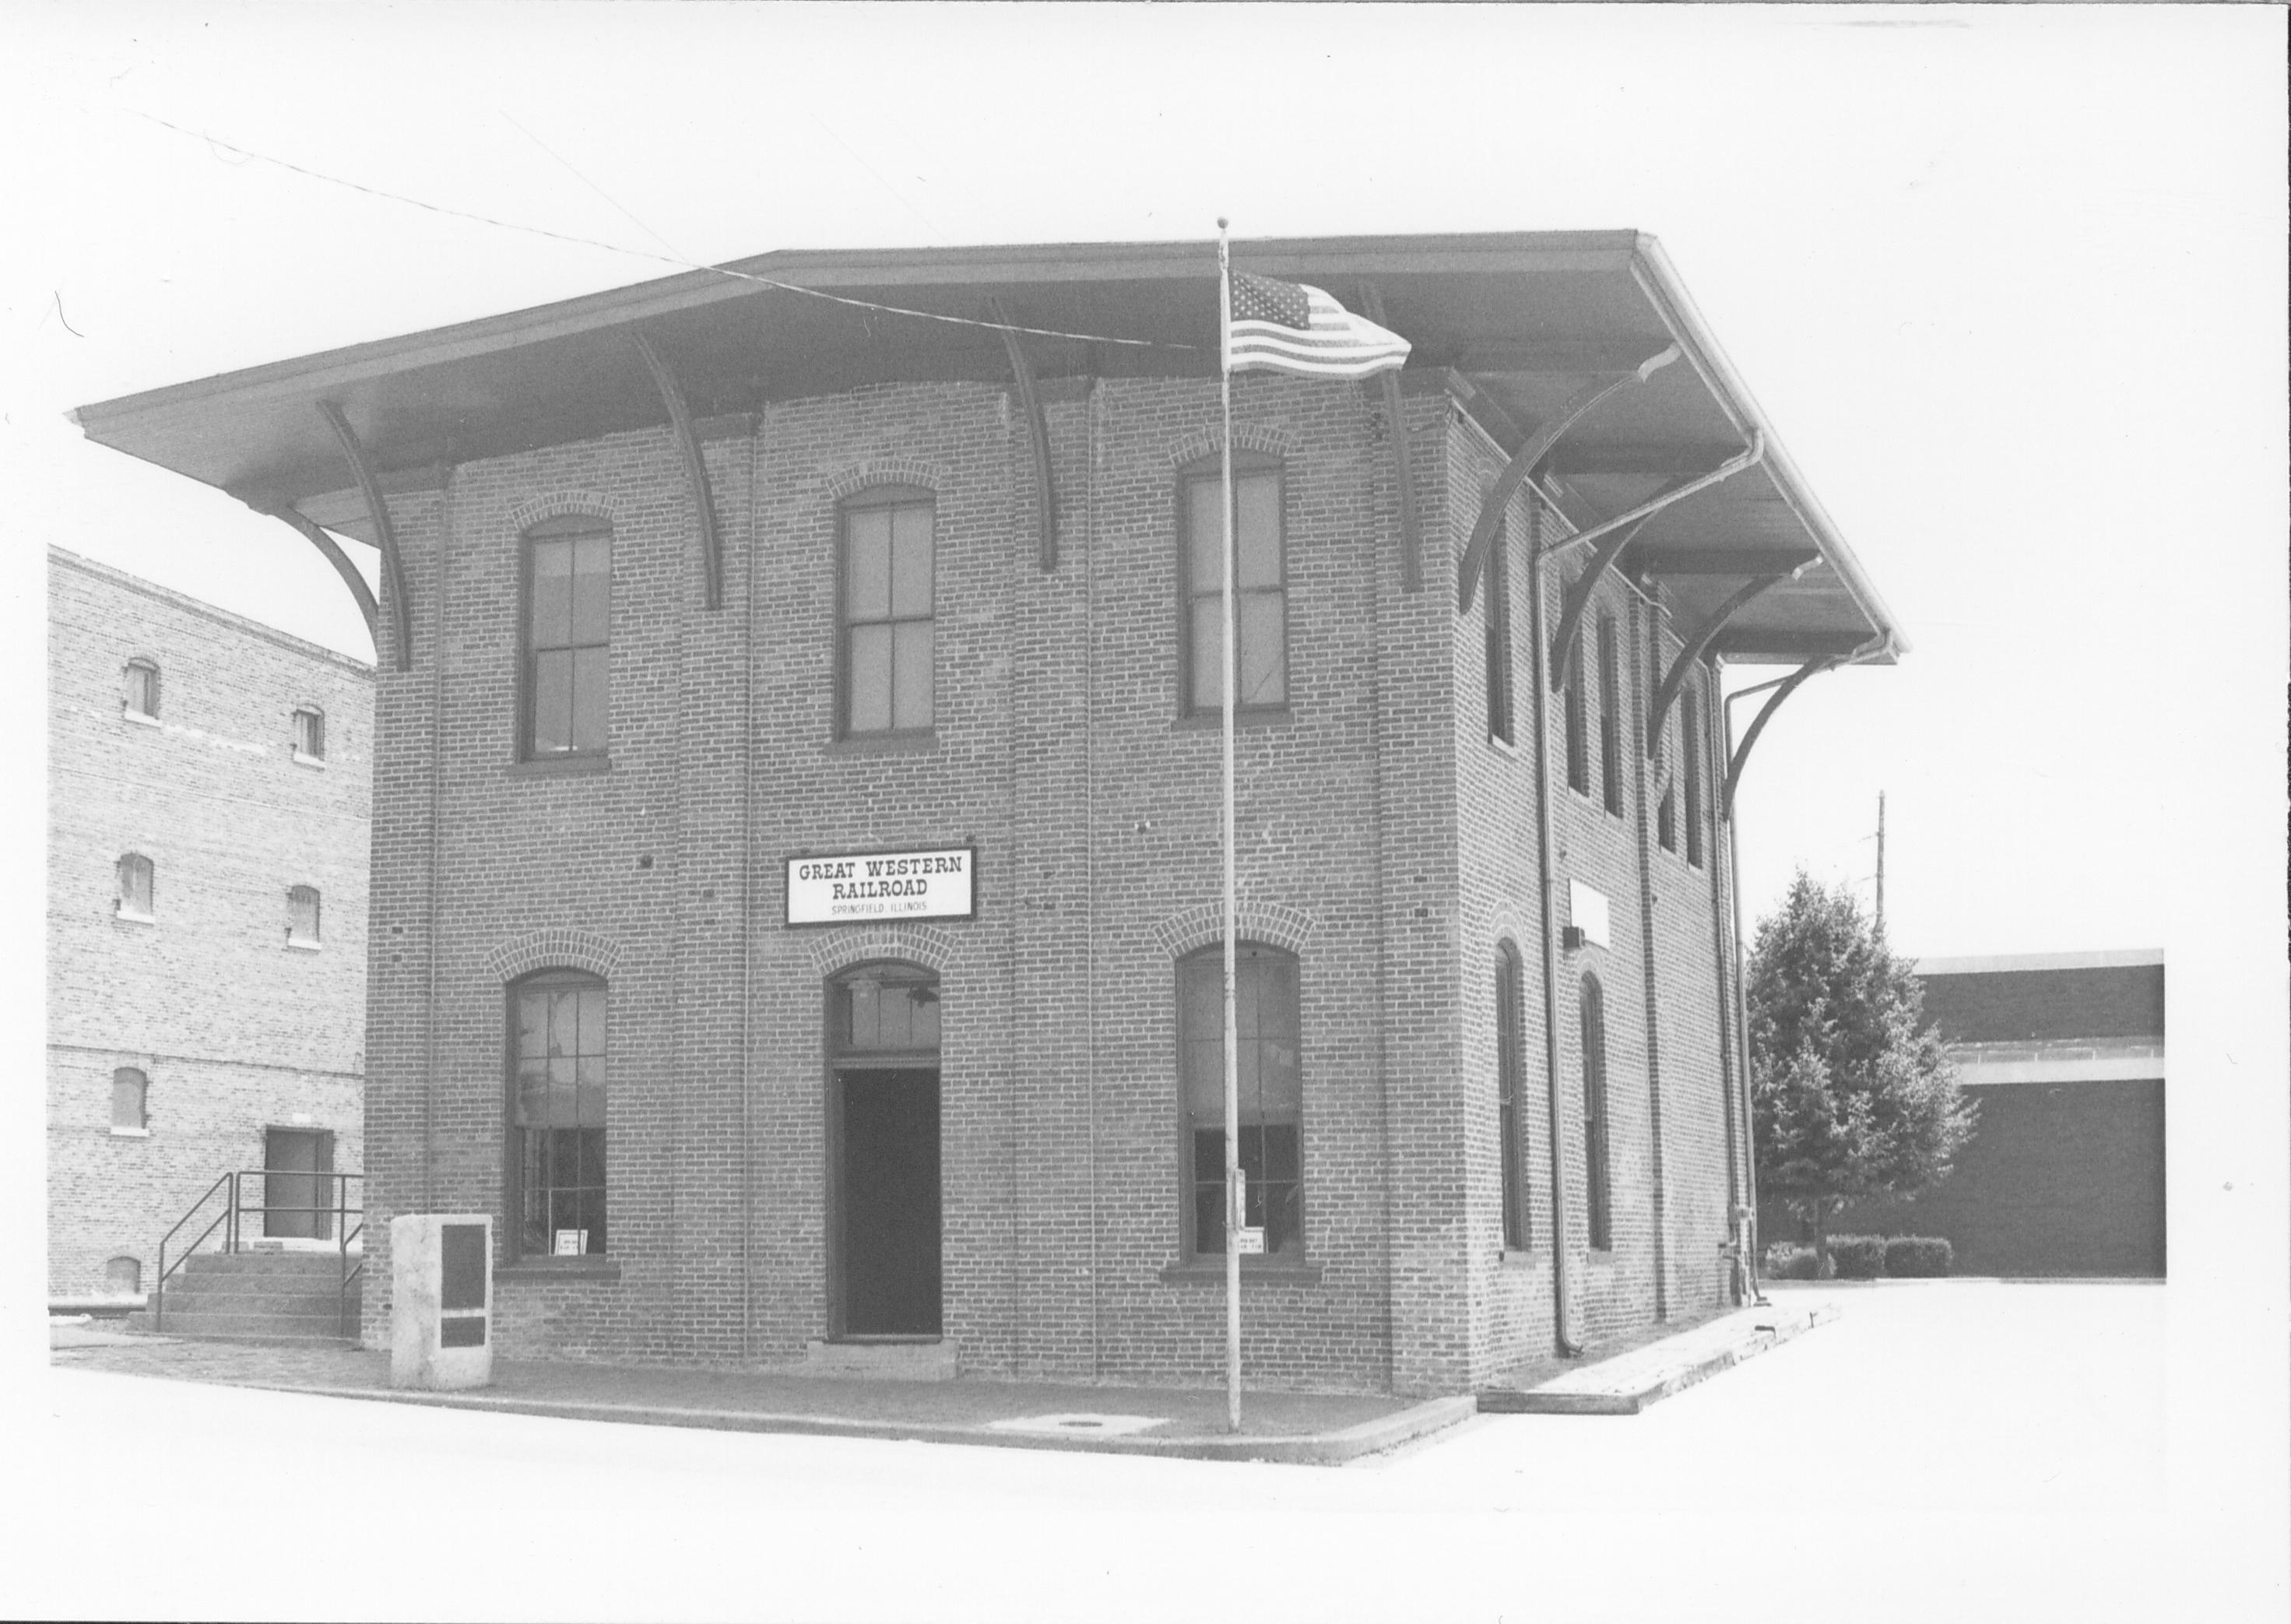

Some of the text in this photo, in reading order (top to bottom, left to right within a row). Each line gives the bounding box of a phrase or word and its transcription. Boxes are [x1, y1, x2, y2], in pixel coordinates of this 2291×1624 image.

[799, 857, 962, 880] GREAT WESTERN
[832, 879, 927, 900] RAILROAD
[891, 902, 927, 912] ILLINOIS
